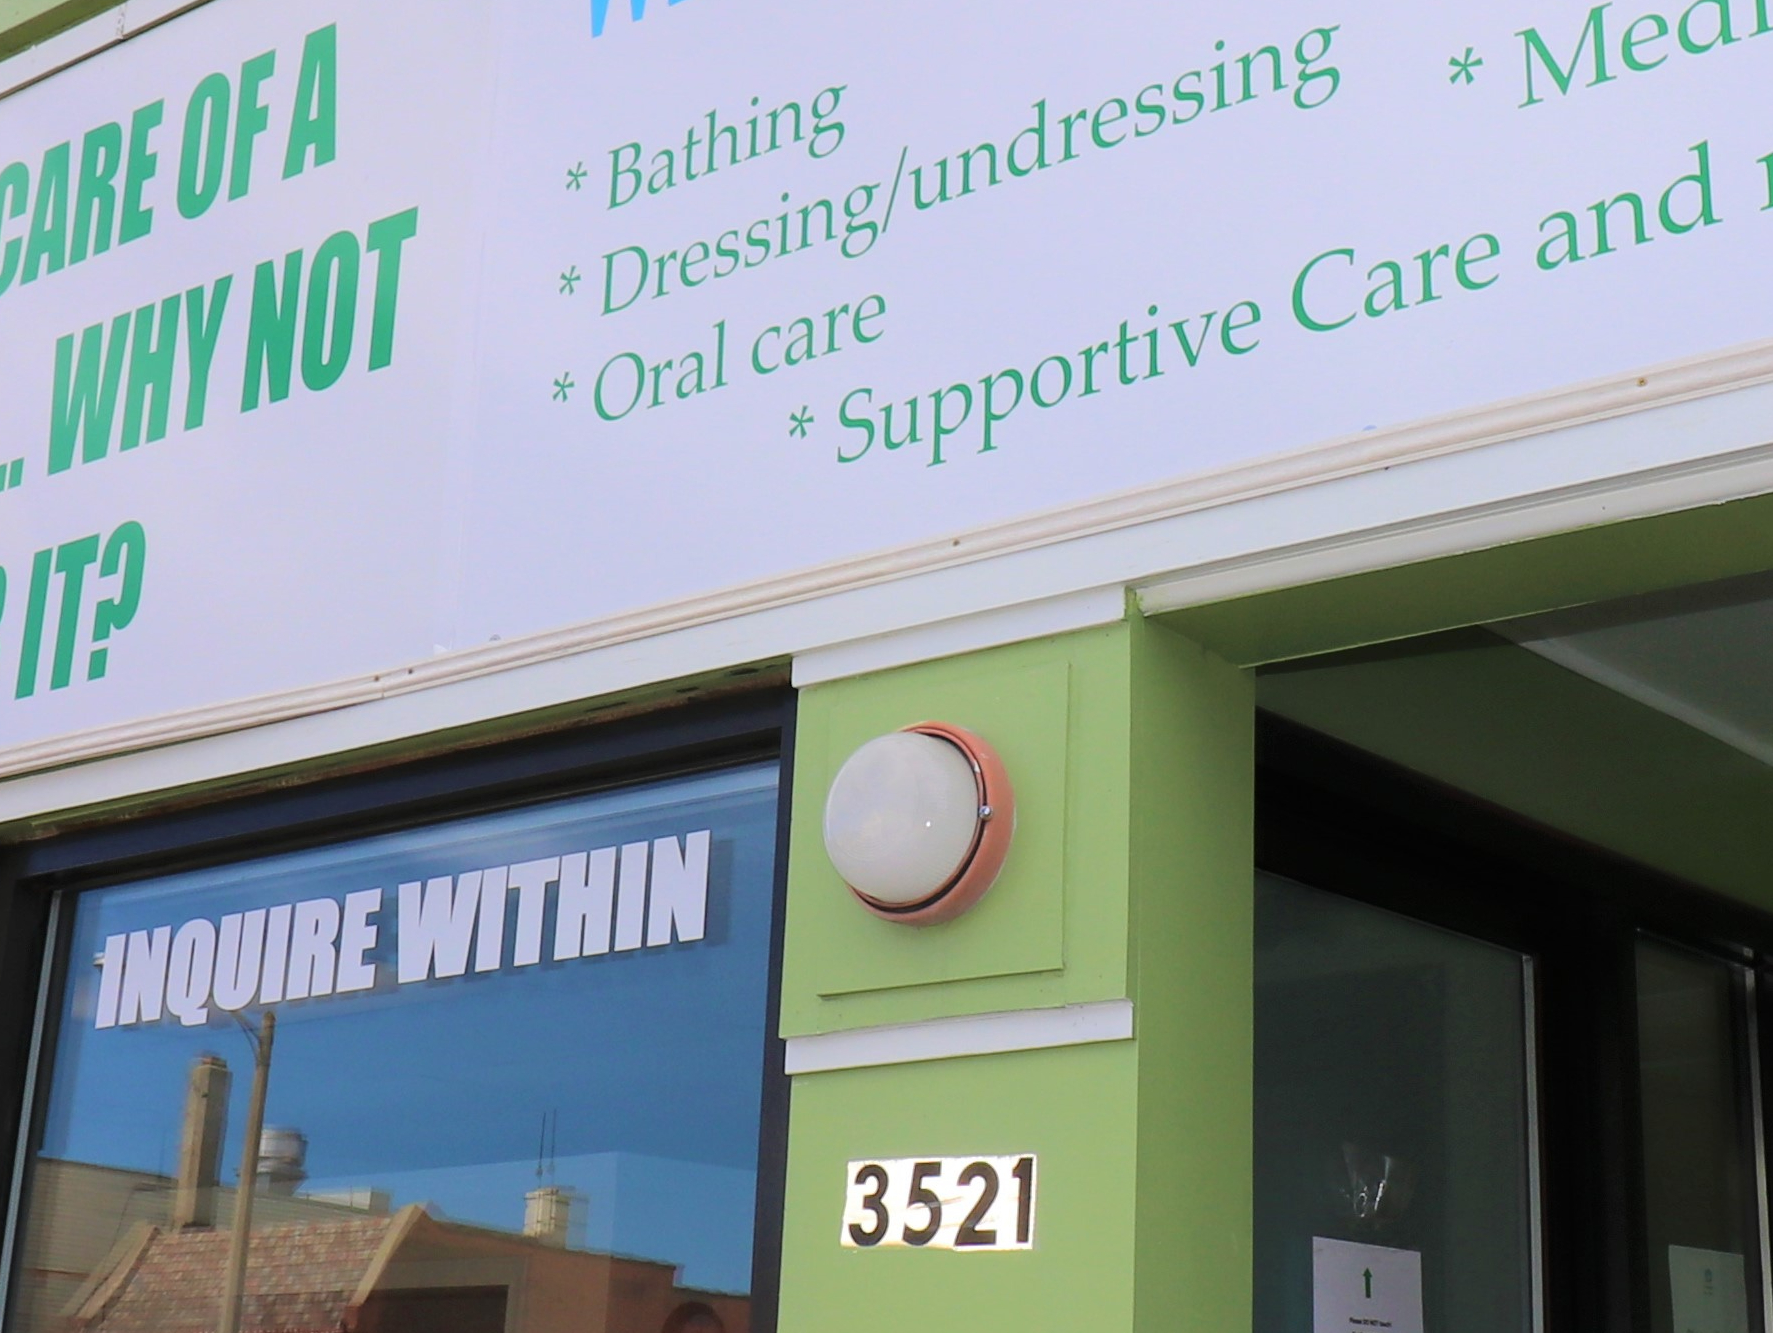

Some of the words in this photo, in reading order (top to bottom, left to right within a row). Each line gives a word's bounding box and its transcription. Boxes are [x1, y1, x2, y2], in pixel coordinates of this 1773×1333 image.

[176, 49, 276, 220] OF
[281, 22, 337, 181] A
[600, 23, 1343, 317] Dressing/undressing
[606, 83, 848, 212] Bathing
[47, 273, 233, 475] WHY
[239, 205, 420, 416] NOT
[591, 319, 728, 423] Oral
[749, 292, 888, 378] care
[834, 298, 1262, 467] Supportive
[1290, 229, 1501, 334] Care
[1534, 141, 1722, 271] and
[15, 518, 147, 700] IT?
[94, 886, 383, 1030] INQUIRE
[397, 829, 712, 985] WITHIN
[847, 1156, 1035, 1248] 3521
